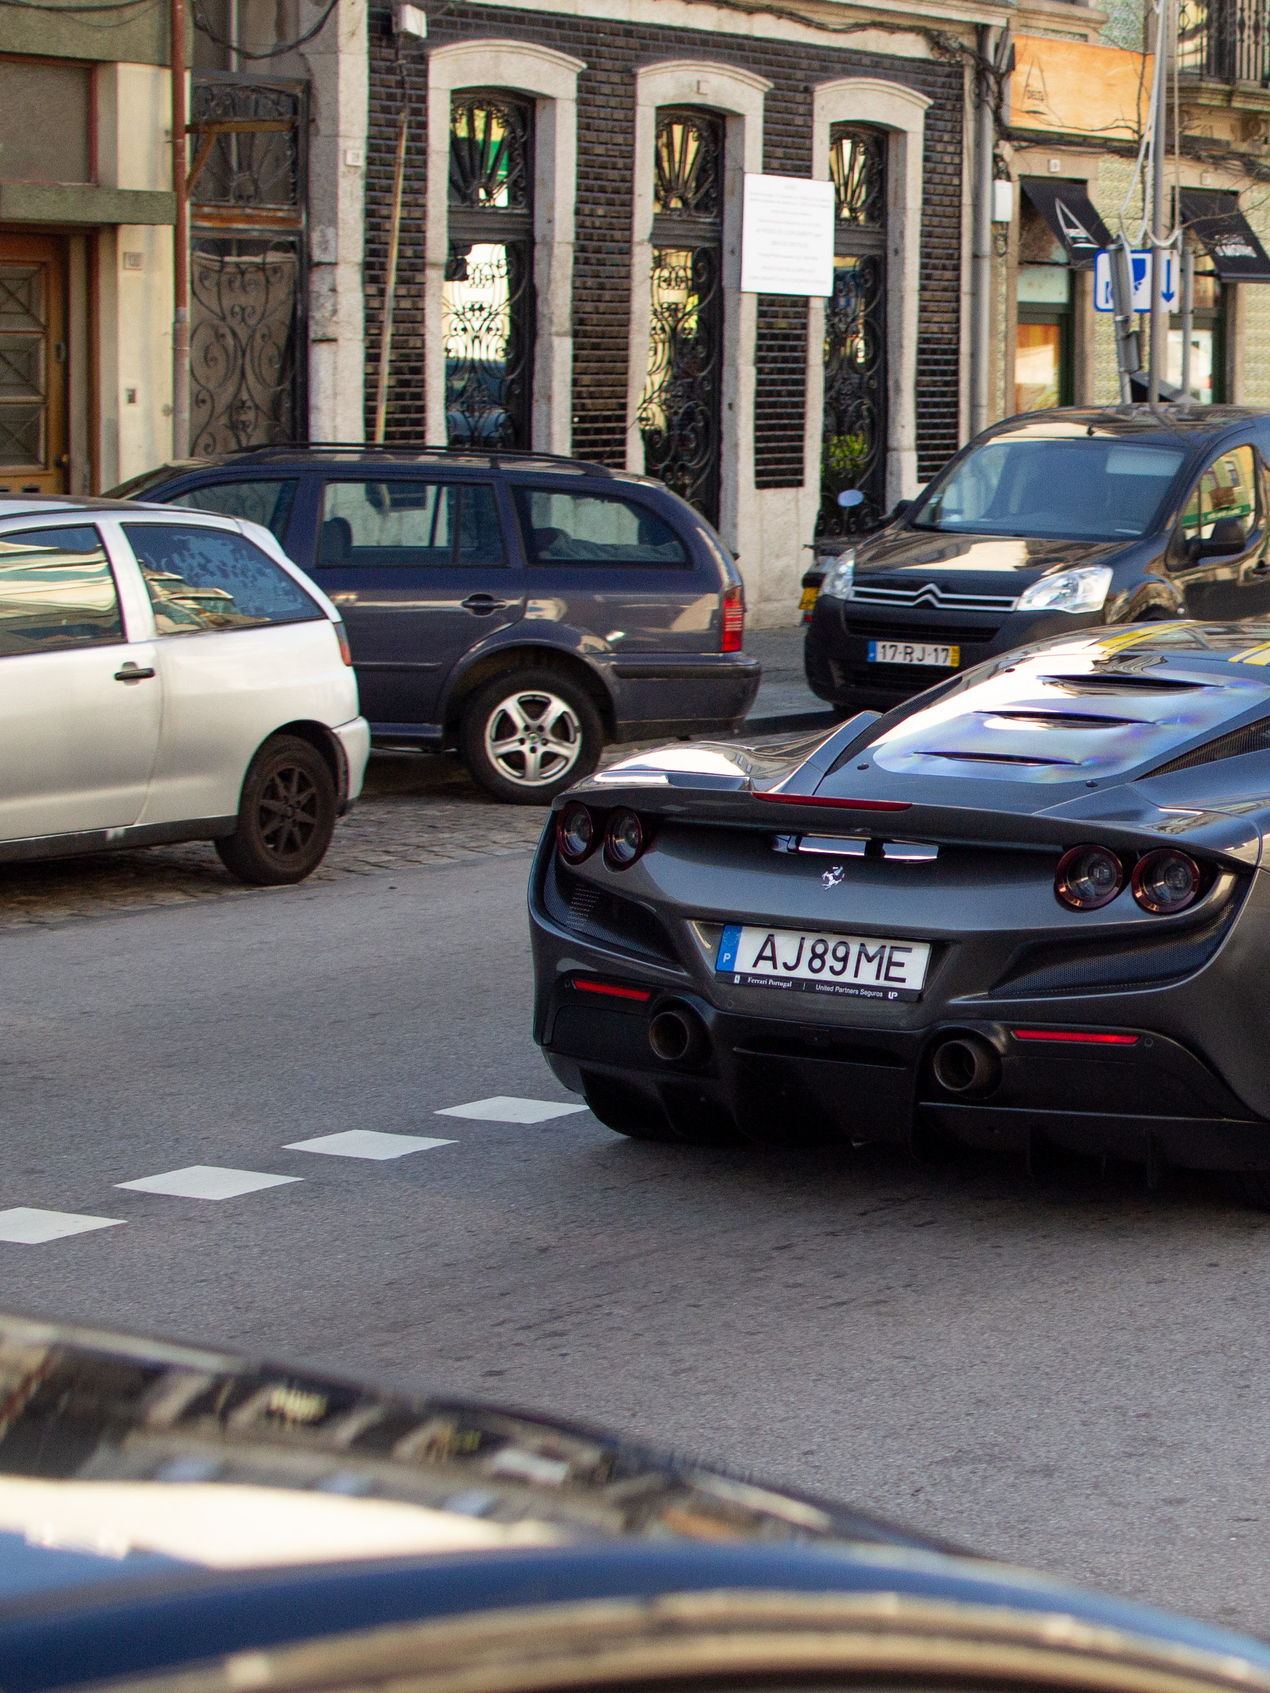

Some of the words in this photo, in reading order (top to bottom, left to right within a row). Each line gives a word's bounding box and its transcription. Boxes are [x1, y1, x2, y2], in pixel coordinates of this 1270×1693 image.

[881, 644, 950, 664] 17-RJ-17
[722, 953, 731, 963] P
[747, 976, 768, 985] Ferrari
[768, 979, 792, 989] Portugal
[815, 984, 834, 993] United
[835, 986, 859, 995] Partners
[860, 988, 883, 998] Seguros
